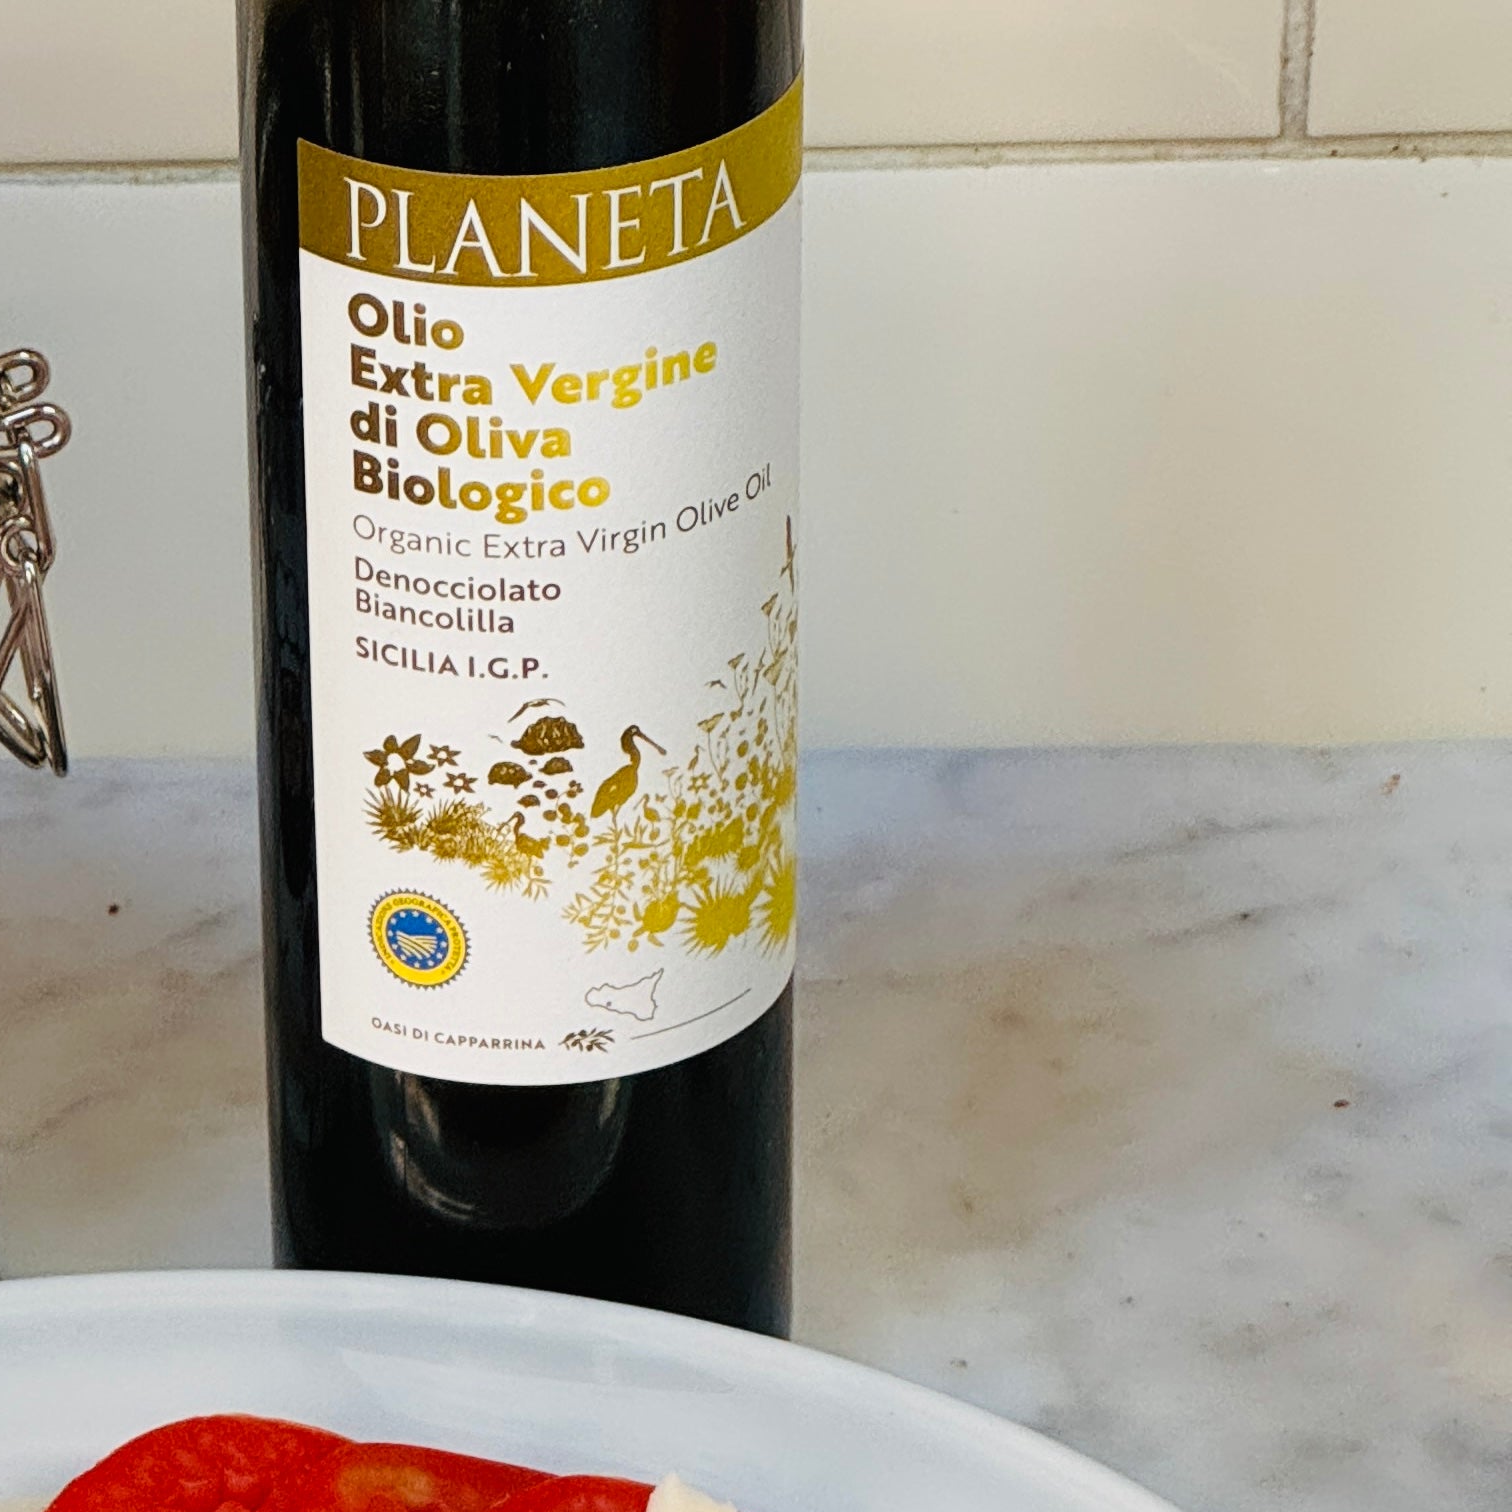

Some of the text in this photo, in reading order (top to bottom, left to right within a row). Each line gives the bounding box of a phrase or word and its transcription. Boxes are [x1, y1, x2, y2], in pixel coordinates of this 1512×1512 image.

[343, 158, 746, 278] PLANETA
[347, 292, 464, 349] Olio
[349, 340, 717, 409] Extra Vergine
[350, 402, 572, 459] di Oliva
[352, 463, 772, 559] Organic Extra Virgin Olive Oil
[353, 449, 611, 525] Biologico
[354, 556, 561, 602] Denocciolato
[355, 588, 514, 634] Biancolilla
[355, 636, 549, 680] SICILIA I.G.P.
[371, 1016, 546, 1051] OASI DI CAPPARRINA
